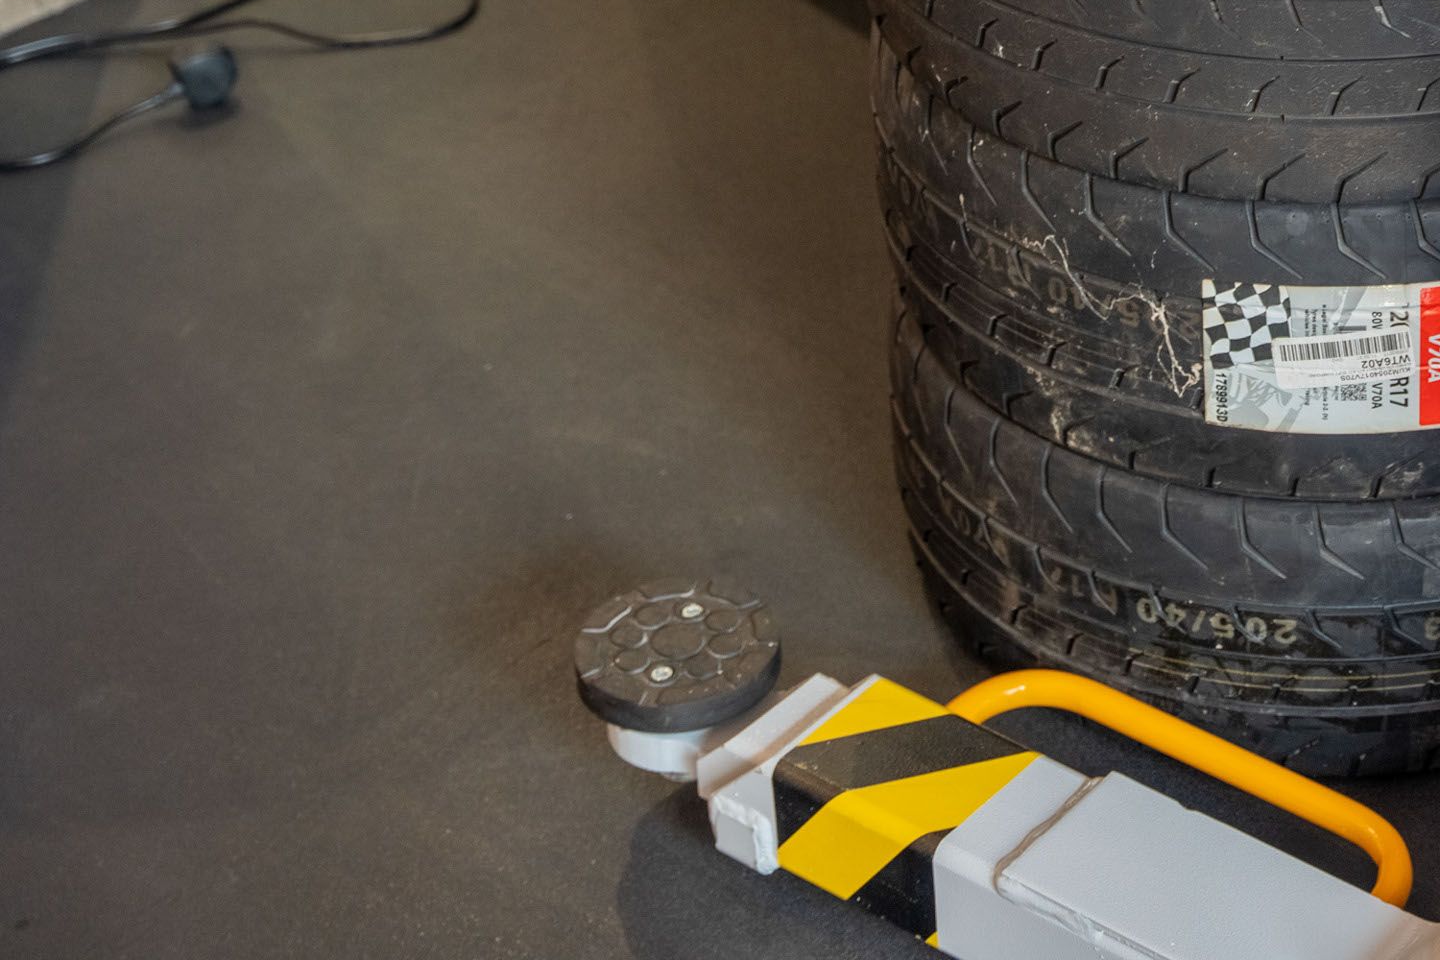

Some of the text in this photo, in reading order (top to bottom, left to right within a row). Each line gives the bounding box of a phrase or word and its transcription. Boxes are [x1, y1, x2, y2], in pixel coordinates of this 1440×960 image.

[1360, 354, 1411, 369] WT6A02
[1215, 372, 1229, 423] 1789913D
[1371, 382, 1383, 409] V70A
[1389, 376, 1410, 408] R17
[1135, 597, 1298, 645] 205/40
